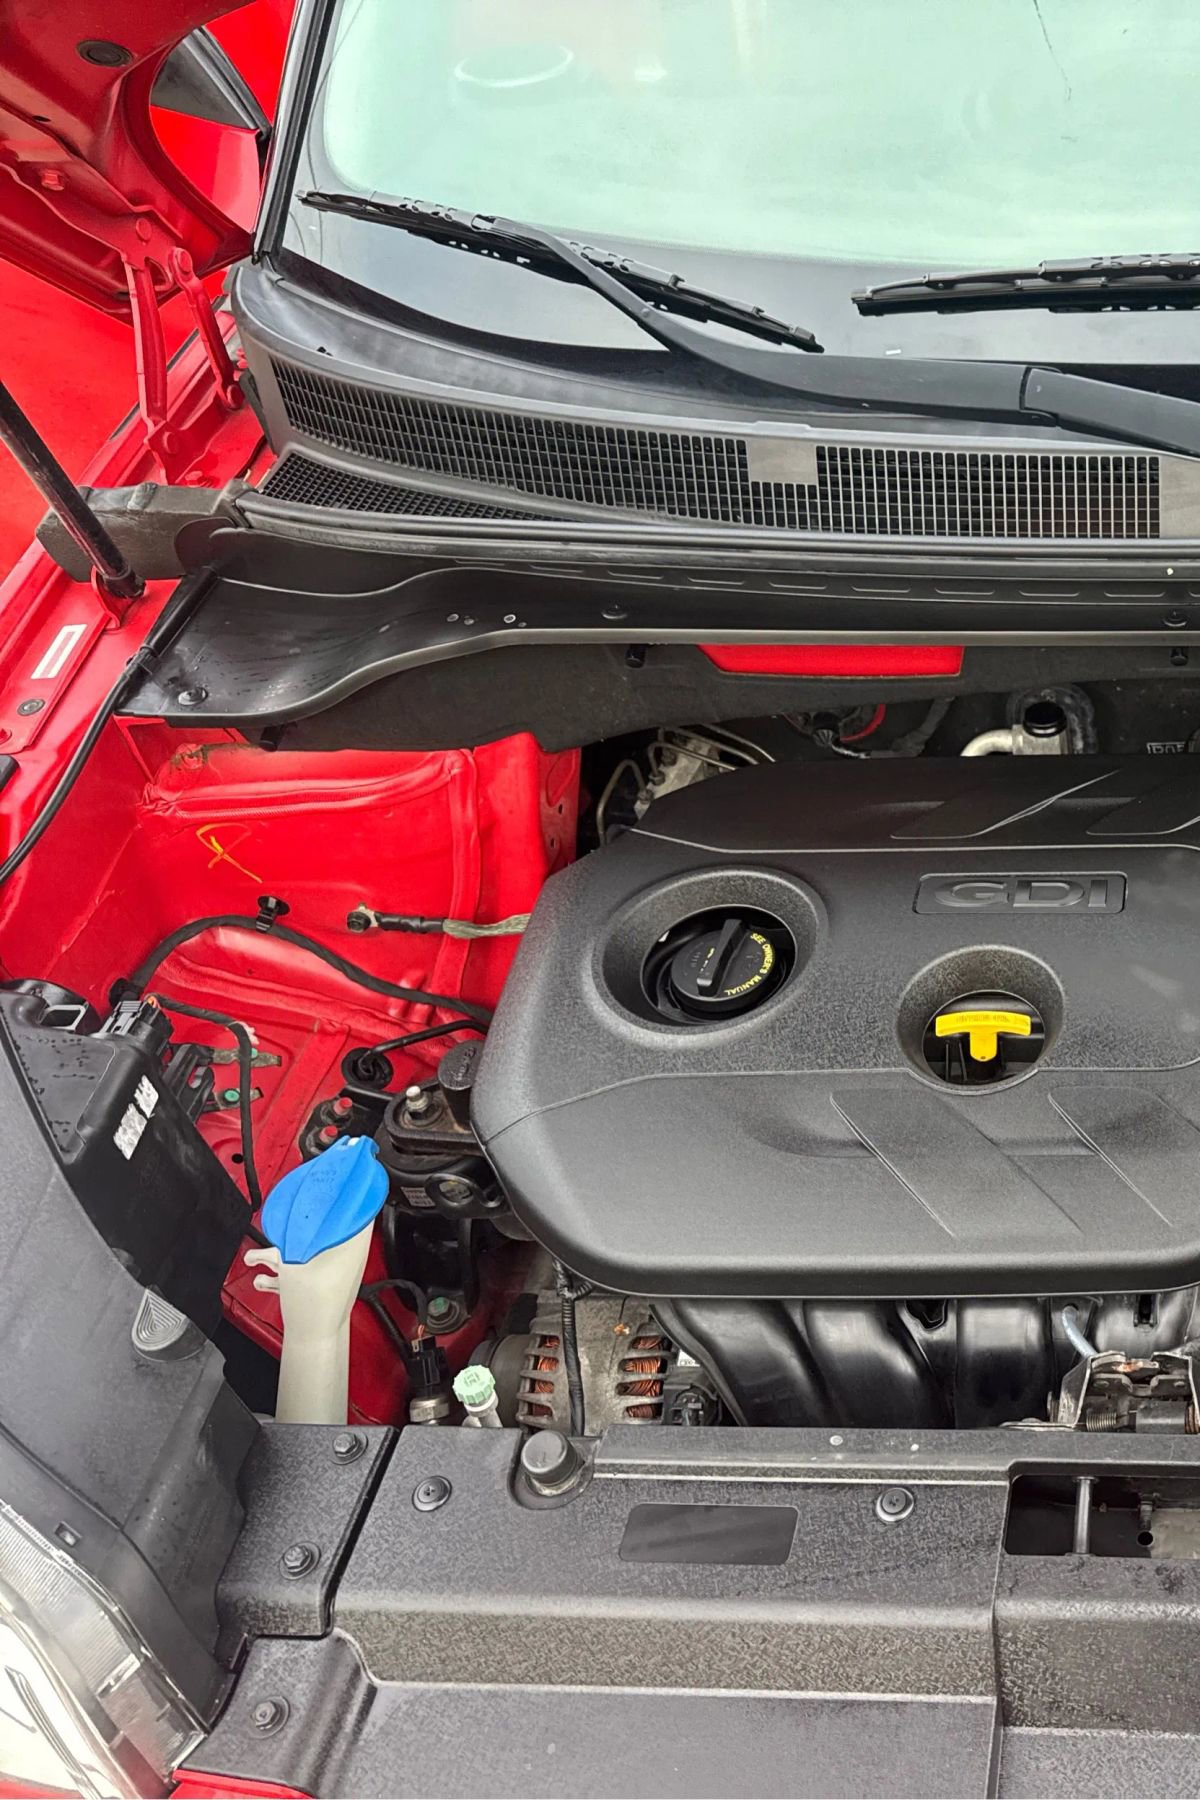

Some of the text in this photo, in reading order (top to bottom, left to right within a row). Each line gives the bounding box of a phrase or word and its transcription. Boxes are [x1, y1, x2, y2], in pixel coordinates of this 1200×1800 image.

[935, 878, 1109, 908] GDI
[723, 932, 774, 996] SEE OWNER'S MANUAL
